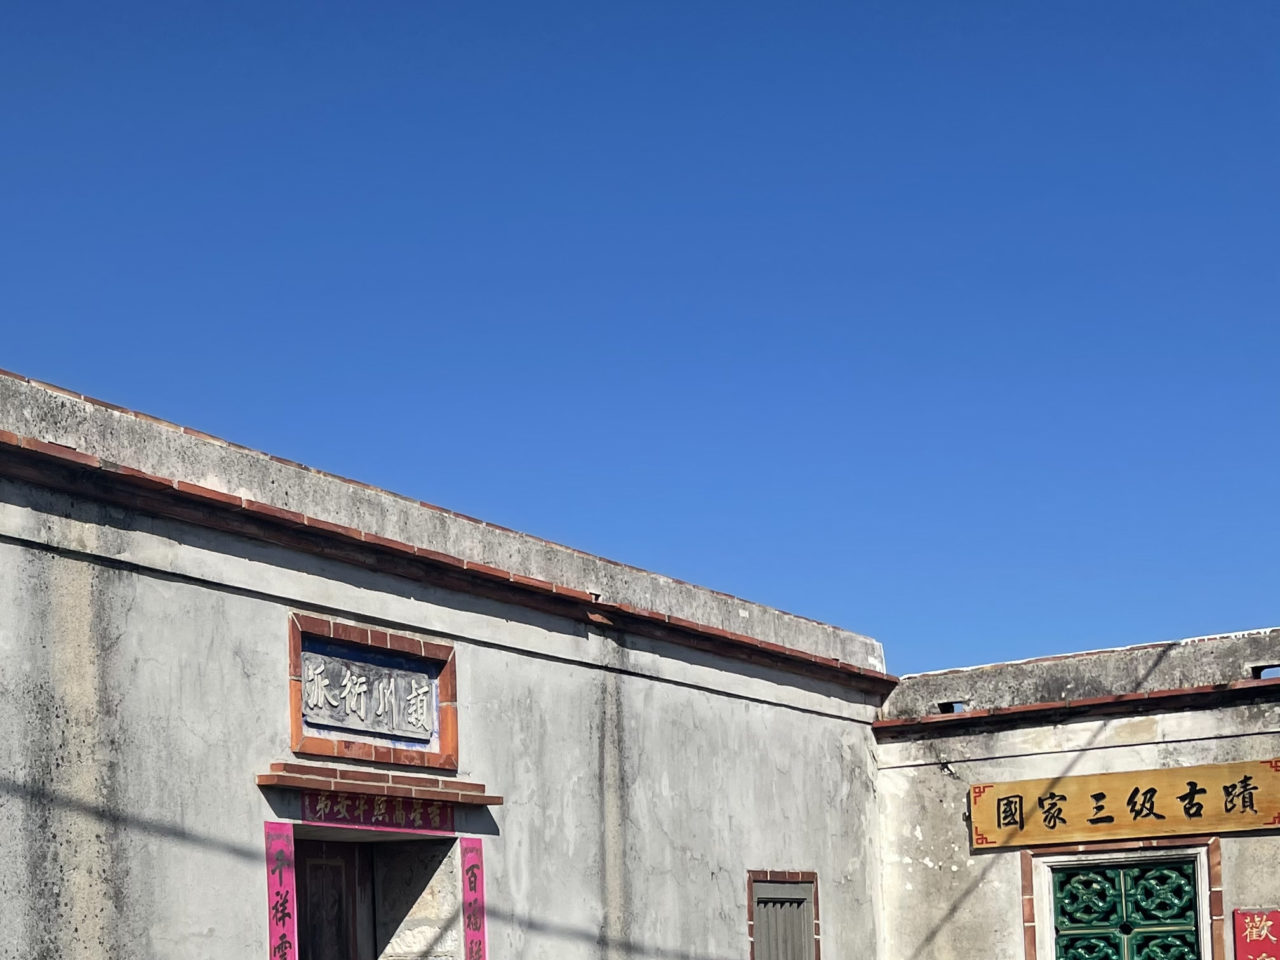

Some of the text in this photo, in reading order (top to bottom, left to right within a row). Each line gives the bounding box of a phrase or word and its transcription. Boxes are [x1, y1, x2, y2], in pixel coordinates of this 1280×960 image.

[996, 775, 1259, 831] 國家三級古蹟
